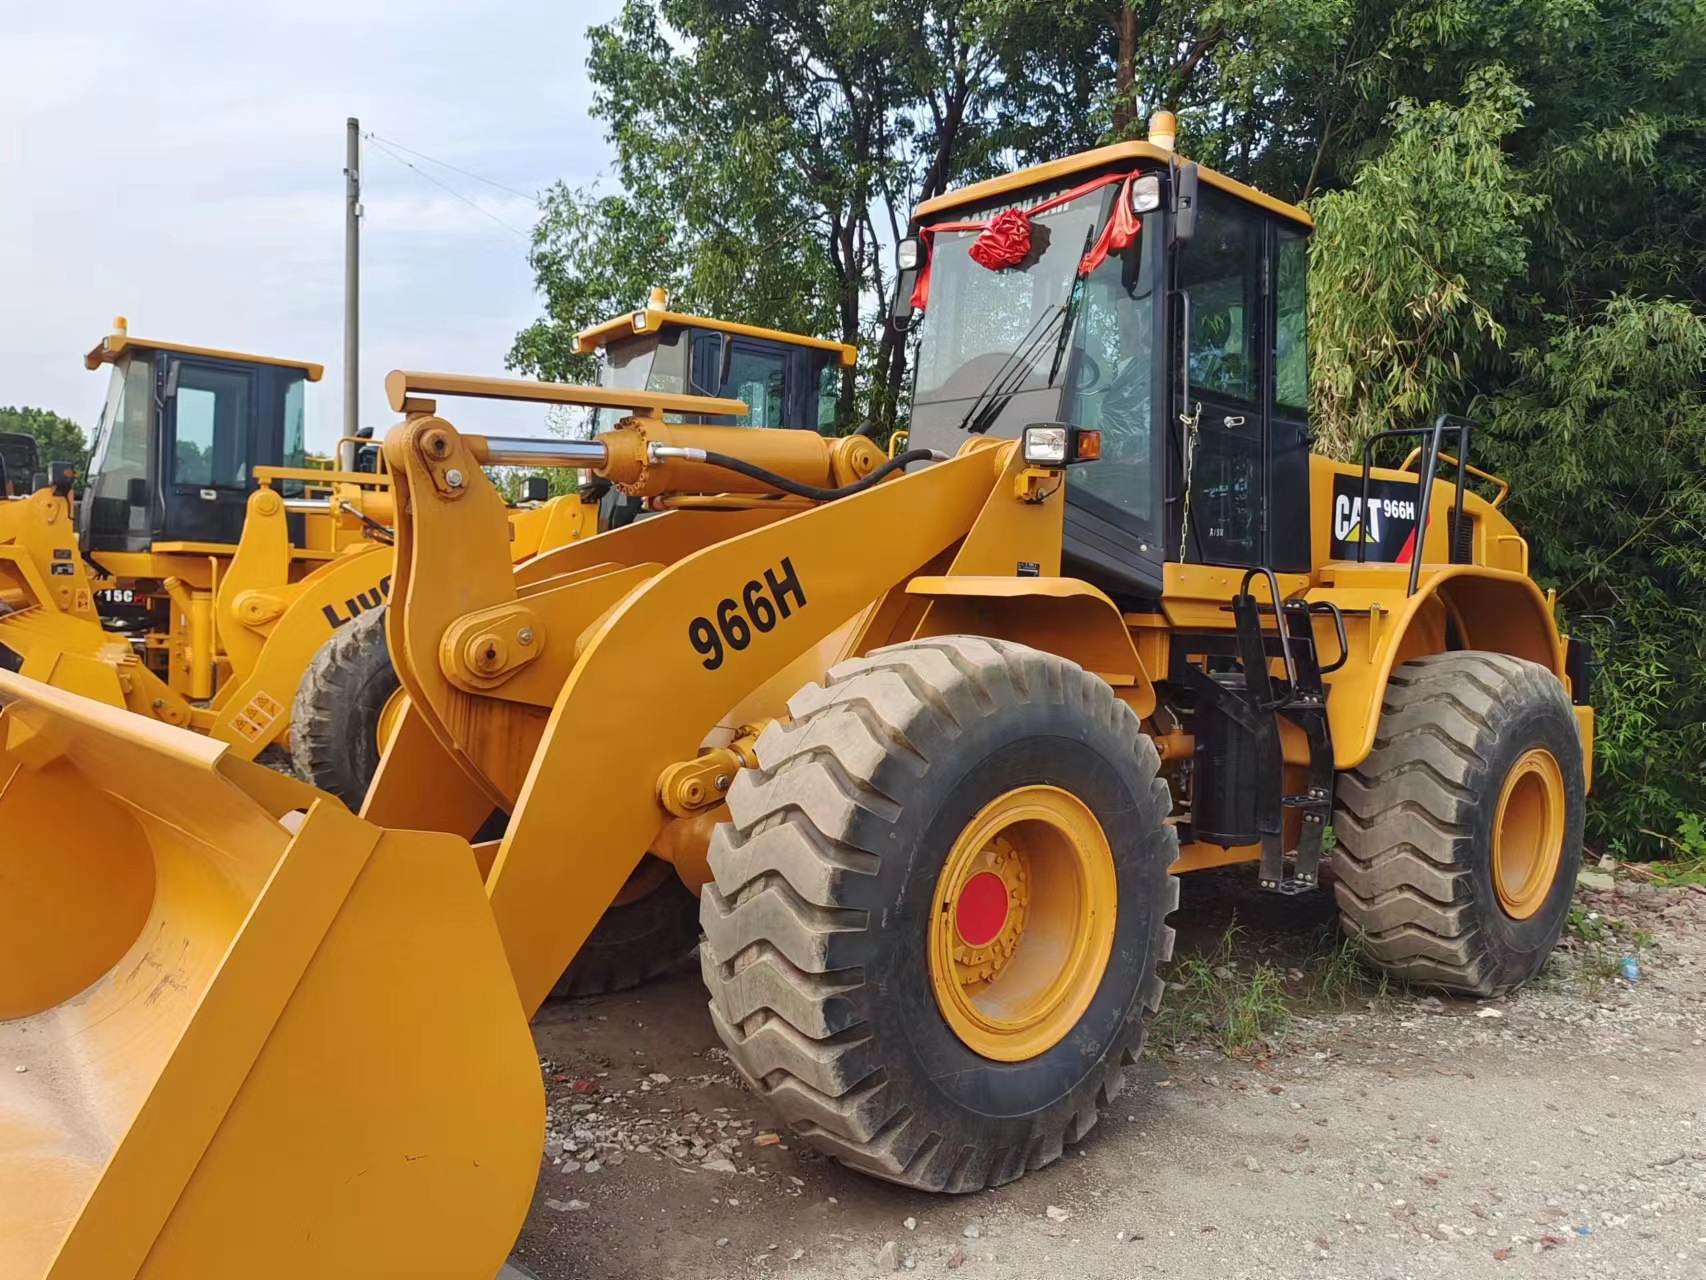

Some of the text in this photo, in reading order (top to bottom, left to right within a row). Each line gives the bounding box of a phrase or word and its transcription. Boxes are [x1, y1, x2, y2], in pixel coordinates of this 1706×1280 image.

[1335, 494, 1415, 543] CAT 966H
[97, 589, 133, 603] 15C
[689, 556, 807, 671] 966H
